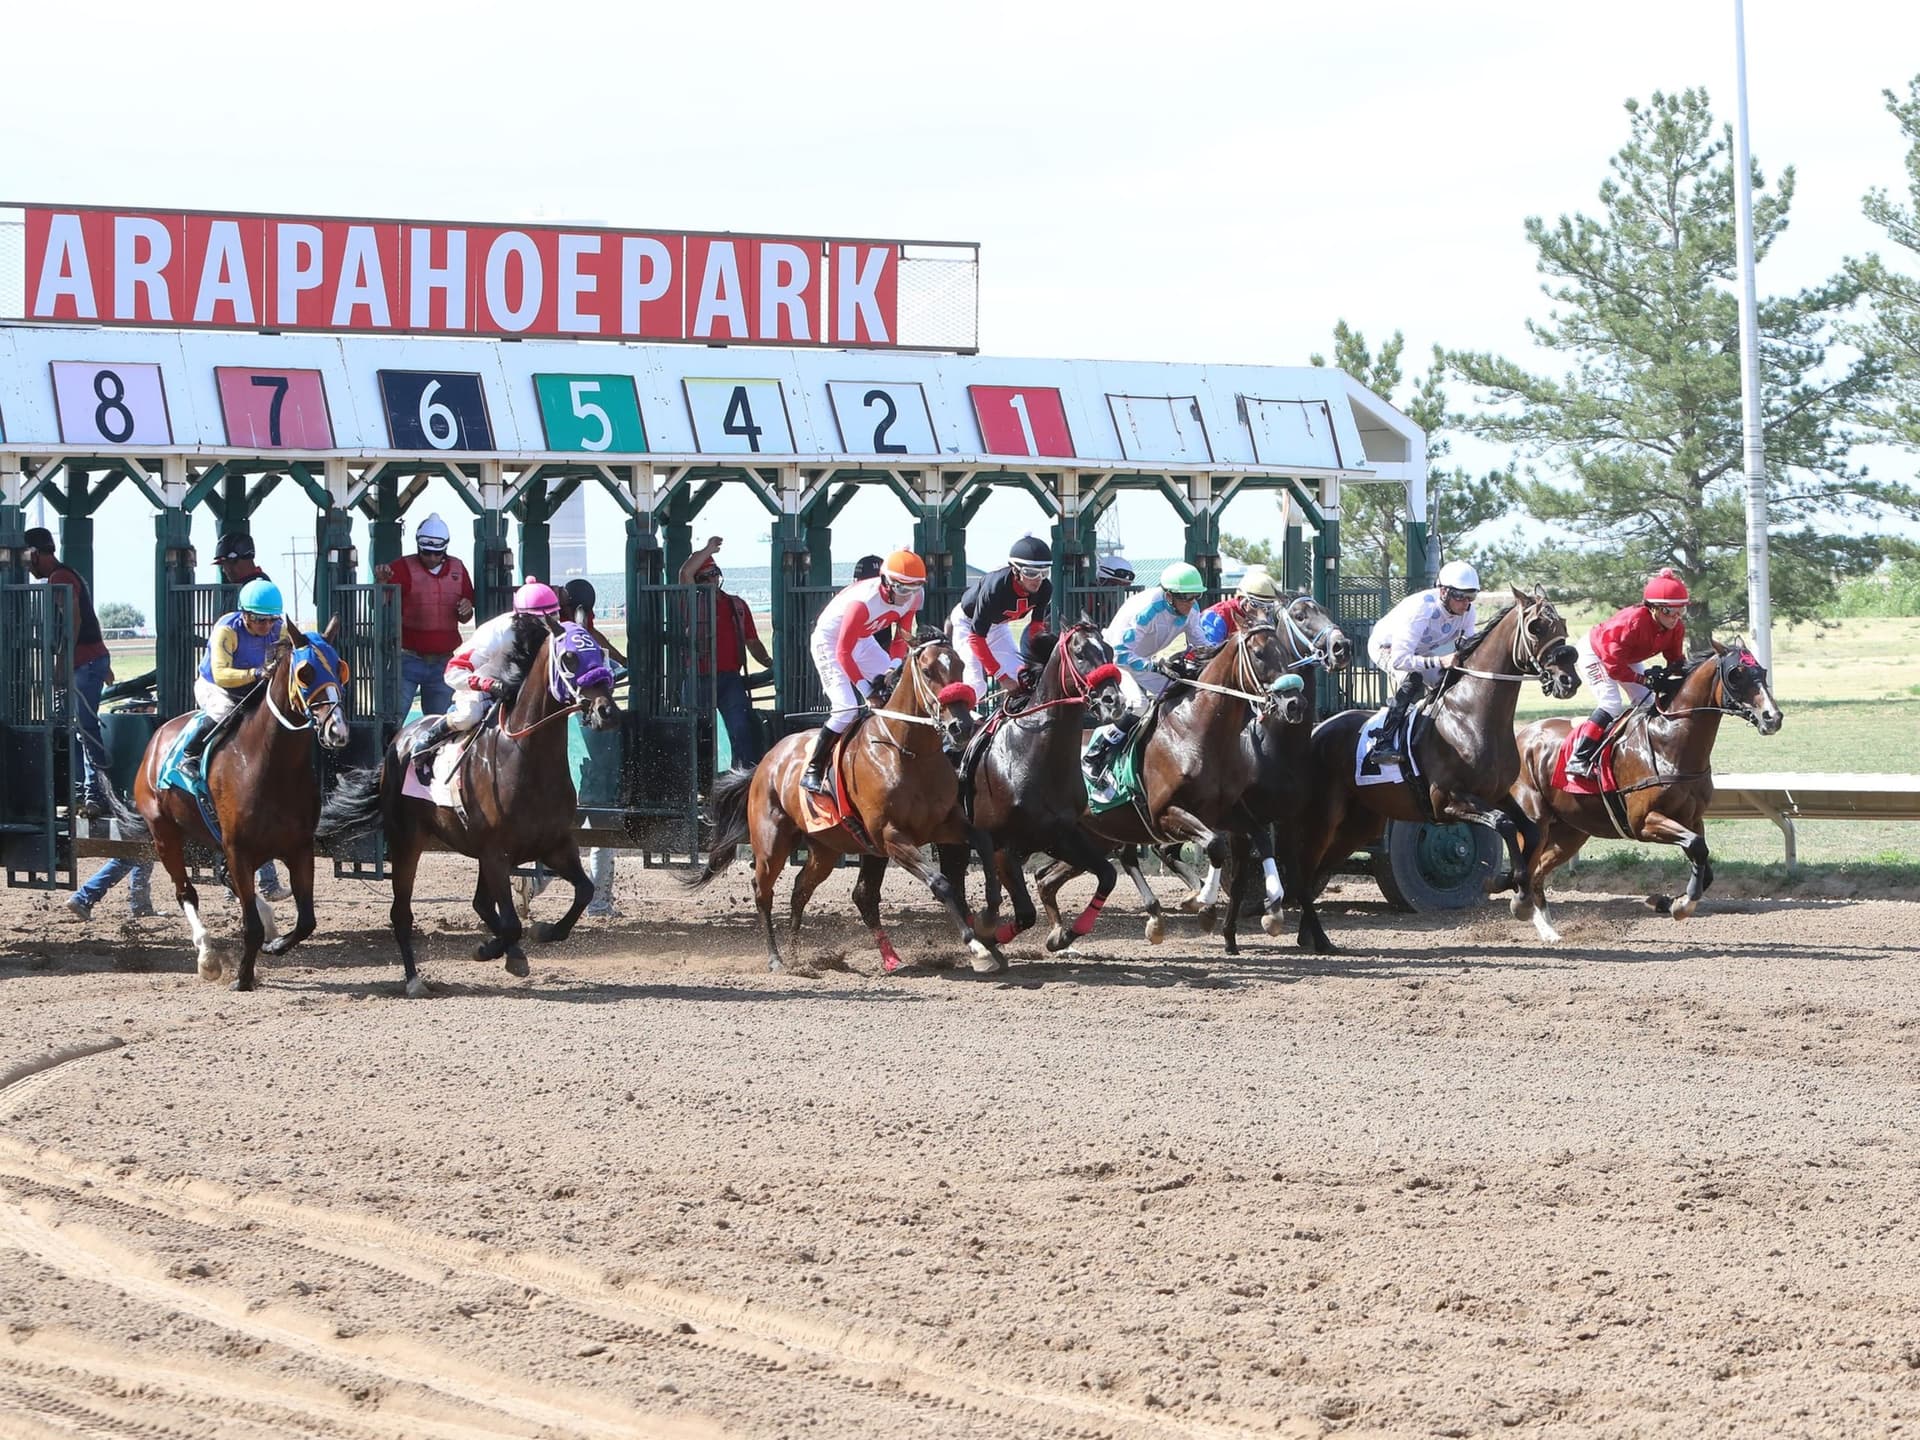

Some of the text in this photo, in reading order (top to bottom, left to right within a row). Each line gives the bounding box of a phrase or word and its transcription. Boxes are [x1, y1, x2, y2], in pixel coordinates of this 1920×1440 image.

[94, 369, 135, 443] 8
[251, 375, 290, 447] 7
[418, 379, 459, 450] 6
[568, 381, 613, 452] 5
[722, 385, 763, 453] 4
[863, 389, 908, 454] 2
[1008, 393, 1041, 457] 1
[571, 633, 594, 648] SS
